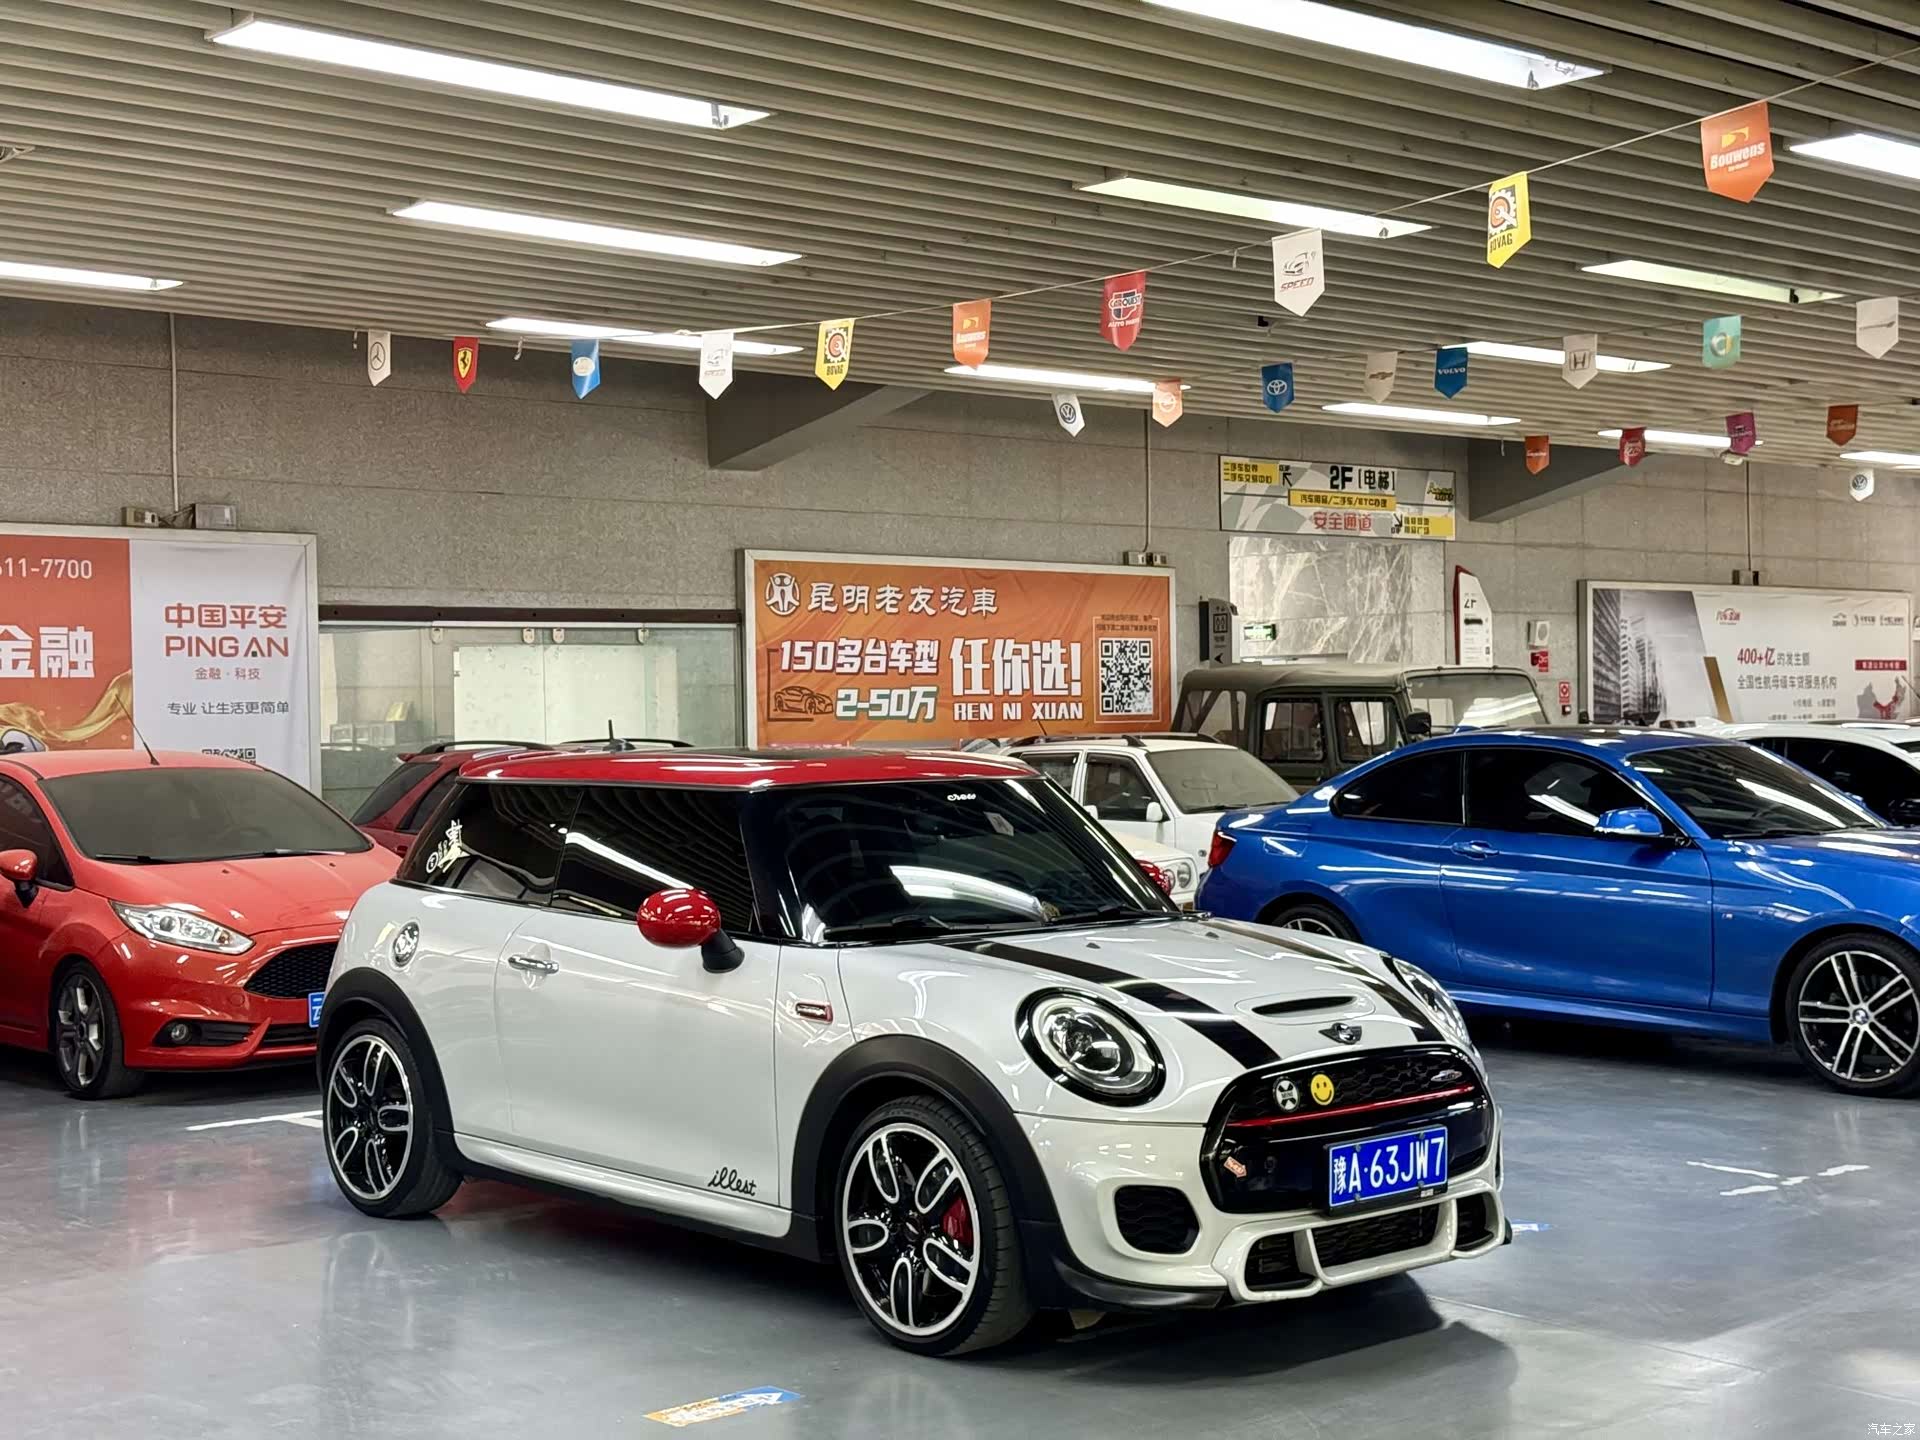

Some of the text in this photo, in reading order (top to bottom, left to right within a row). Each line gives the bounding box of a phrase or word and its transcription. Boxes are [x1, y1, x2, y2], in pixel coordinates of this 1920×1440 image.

[1280, 277, 1314, 292] SPEED
[1108, 320, 1125, 328] AUTO
[1437, 367, 1466, 375] VOLVO
[1330, 466, 1353, 490] 2F
[1313, 511, 1372, 531] 安全通道
[0, 557, 93, 579] 11-7700
[808, 582, 999, 616] 昆明老友汽車
[164, 603, 288, 629] 中国平安
[0, 624, 95, 679] 金融
[780, 639, 940, 674] 150多台车型
[167, 701, 290, 716] 专业 让生活更简单
[835, 686, 938, 722] 2-50万
[953, 701, 1083, 721] REN NI XUAN
[708, 1166, 757, 1196] illest
